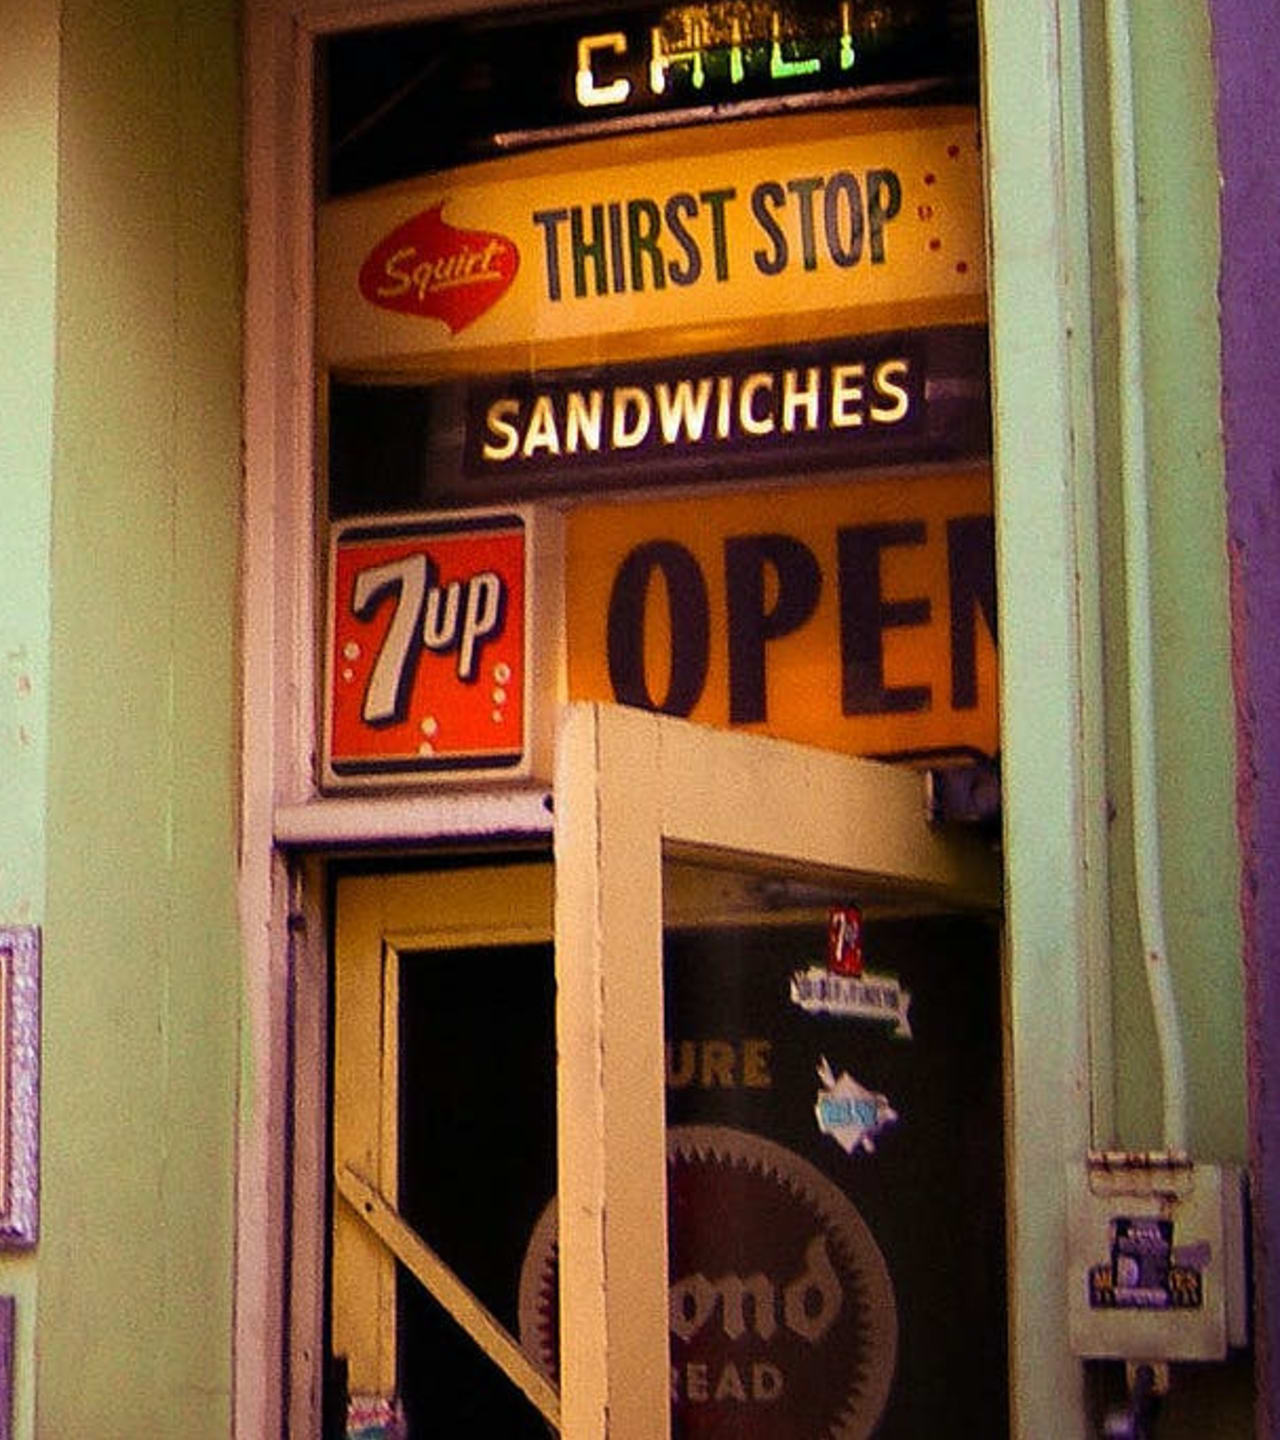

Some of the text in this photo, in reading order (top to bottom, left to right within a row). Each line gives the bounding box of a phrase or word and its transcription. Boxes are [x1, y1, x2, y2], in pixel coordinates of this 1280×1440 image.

[575, 0, 857, 108] CHILI
[375, 236, 512, 303] Squirt
[532, 168, 903, 303] THIRST STOP
[482, 360, 911, 461] SANDWICHES
[664, 1039, 773, 1088] URE
[669, 1233, 843, 1344] ond
